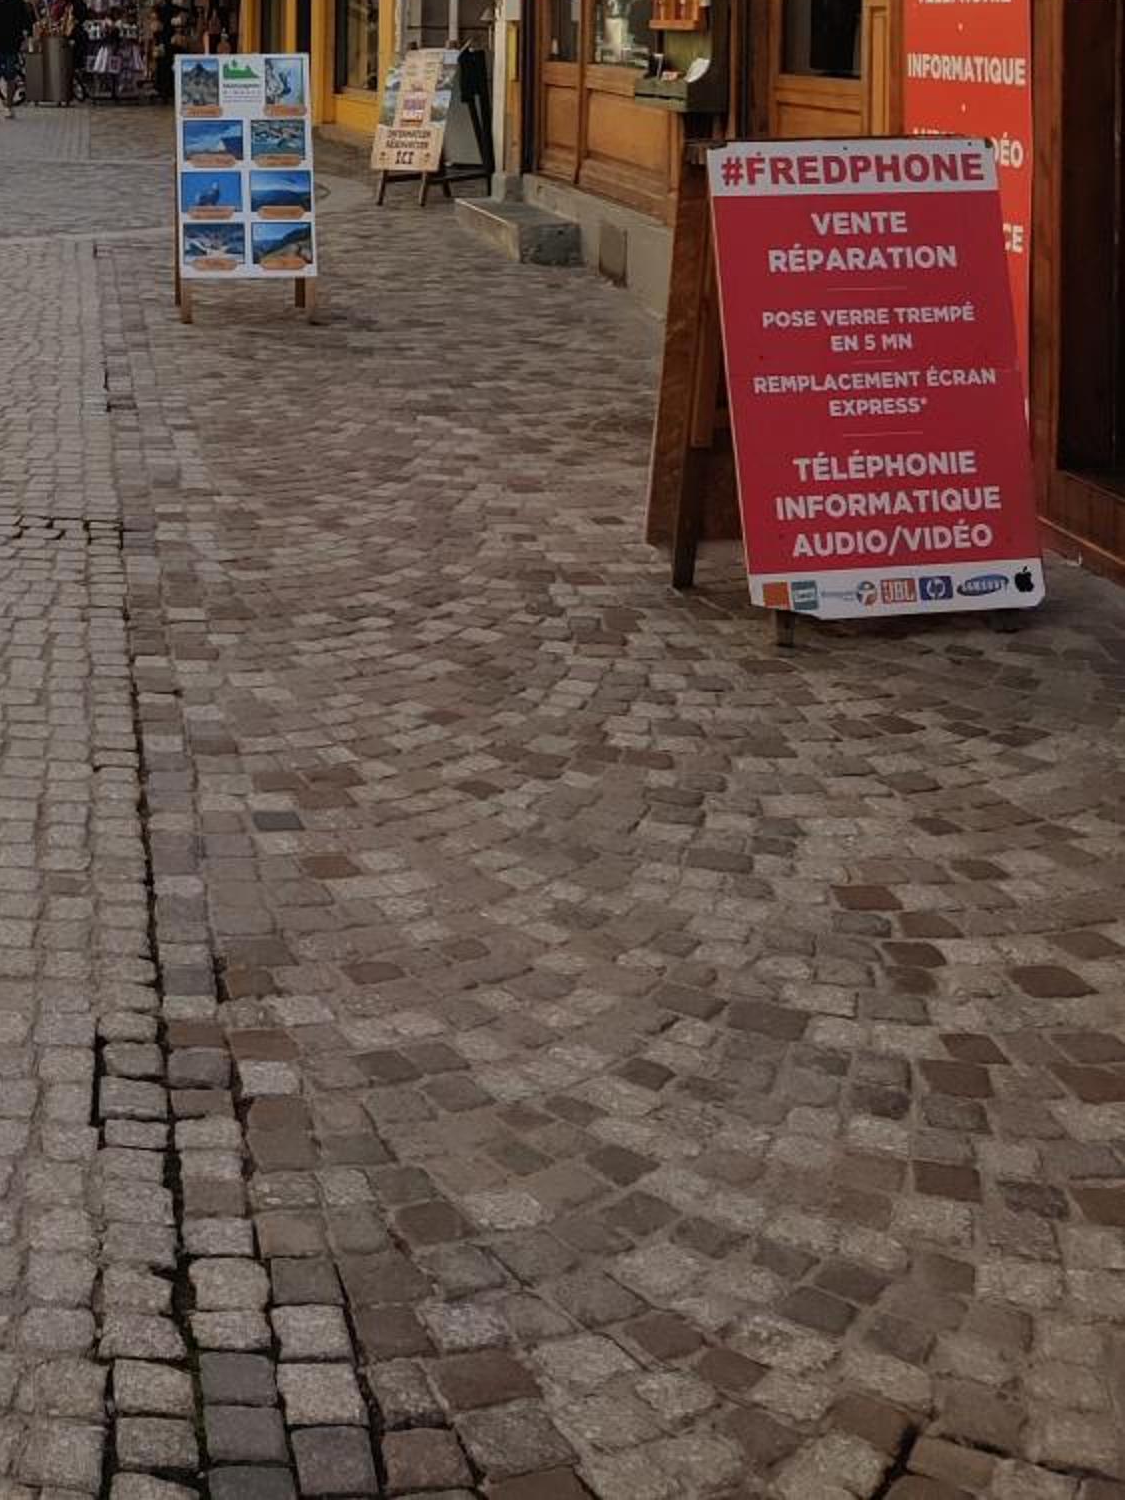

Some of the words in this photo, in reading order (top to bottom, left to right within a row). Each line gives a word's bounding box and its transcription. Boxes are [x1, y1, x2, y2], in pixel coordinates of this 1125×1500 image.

[907, 52, 1026, 85] INFORMATIQUE
[395, 151, 414, 165] ICI
[721, 153, 985, 186] #FREDPHONE
[811, 211, 907, 236] VENTE
[768, 243, 957, 272] RÉPARATION
[762, 310, 817, 328] POSE
[823, 307, 890, 326] VERRE
[894, 301, 975, 324] TREMPÉ
[830, 335, 859, 351] EN
[865, 334, 876, 350] 5
[881, 333, 913, 349] MN
[754, 372, 920, 393] REMPLACEMENT
[926, 366, 996, 386] ÉCRAN
[793, 451, 978, 482] TÉLÉPHONIE
[775, 486, 1002, 521] INFORMATIQUE
[792, 519, 993, 557] AUDIO/VIDÉO
[881, 580, 916, 603] JBL
